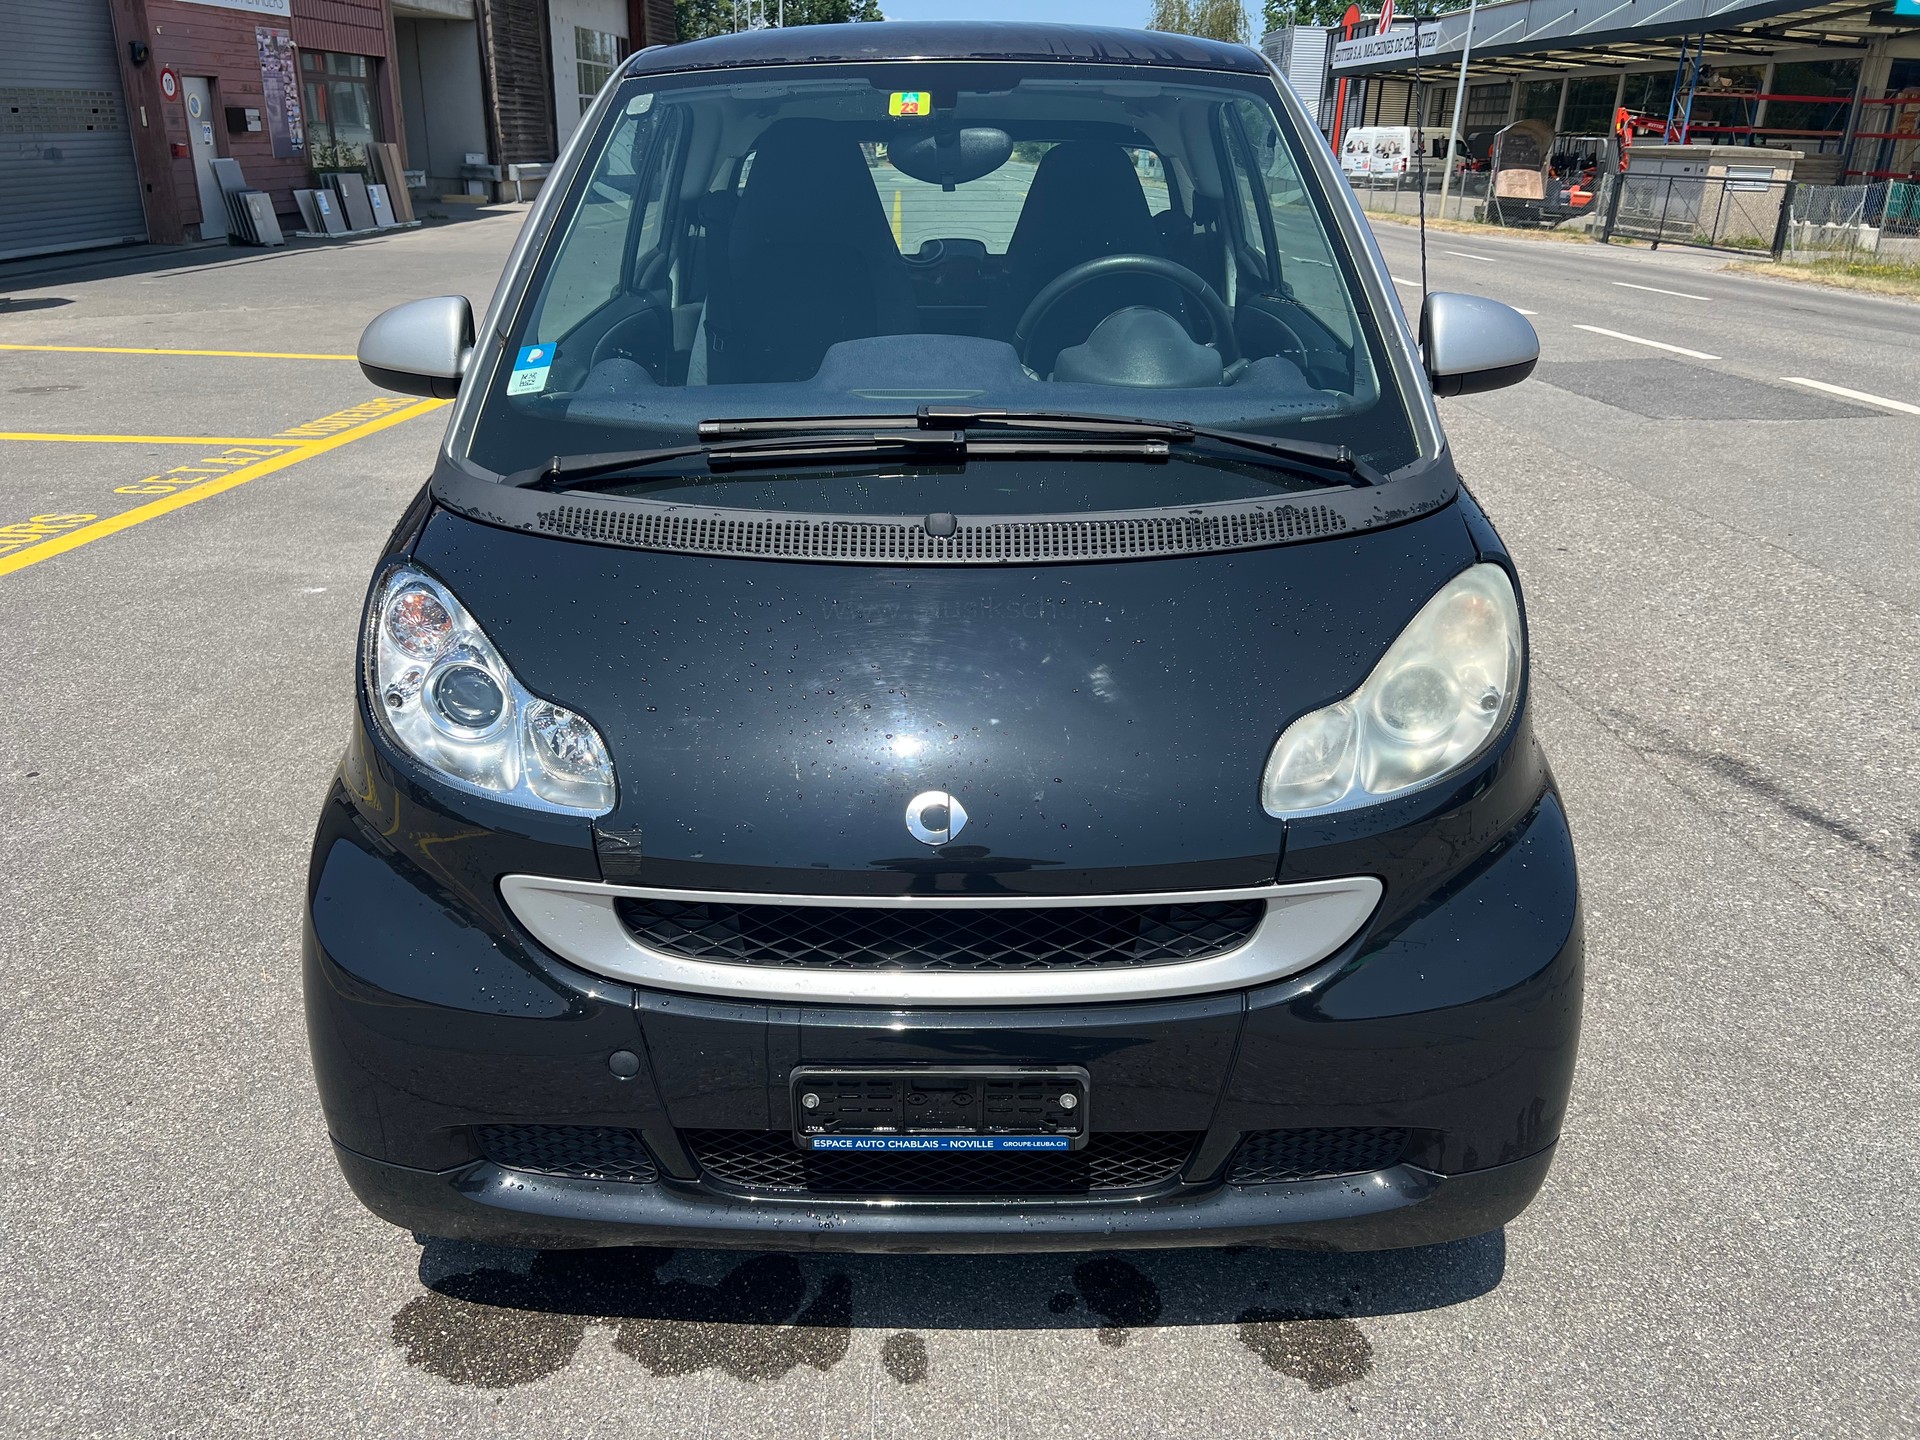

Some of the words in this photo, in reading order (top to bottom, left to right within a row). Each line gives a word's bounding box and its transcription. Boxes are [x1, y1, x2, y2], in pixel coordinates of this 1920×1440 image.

[1363, 39, 1395, 58] MACHINES
[1394, 38, 1403, 53] DE
[164, 78, 173, 92] 10
[900, 102, 919, 113] 23
[272, 397, 418, 436] VISITEURS
[0, 513, 98, 553] URS
[813, 1139, 853, 1148] ESPACE
[855, 1139, 885, 1148] AUTO
[888, 1139, 939, 1148] CHABLAIS
[950, 1140, 994, 1148] NOVILLE
